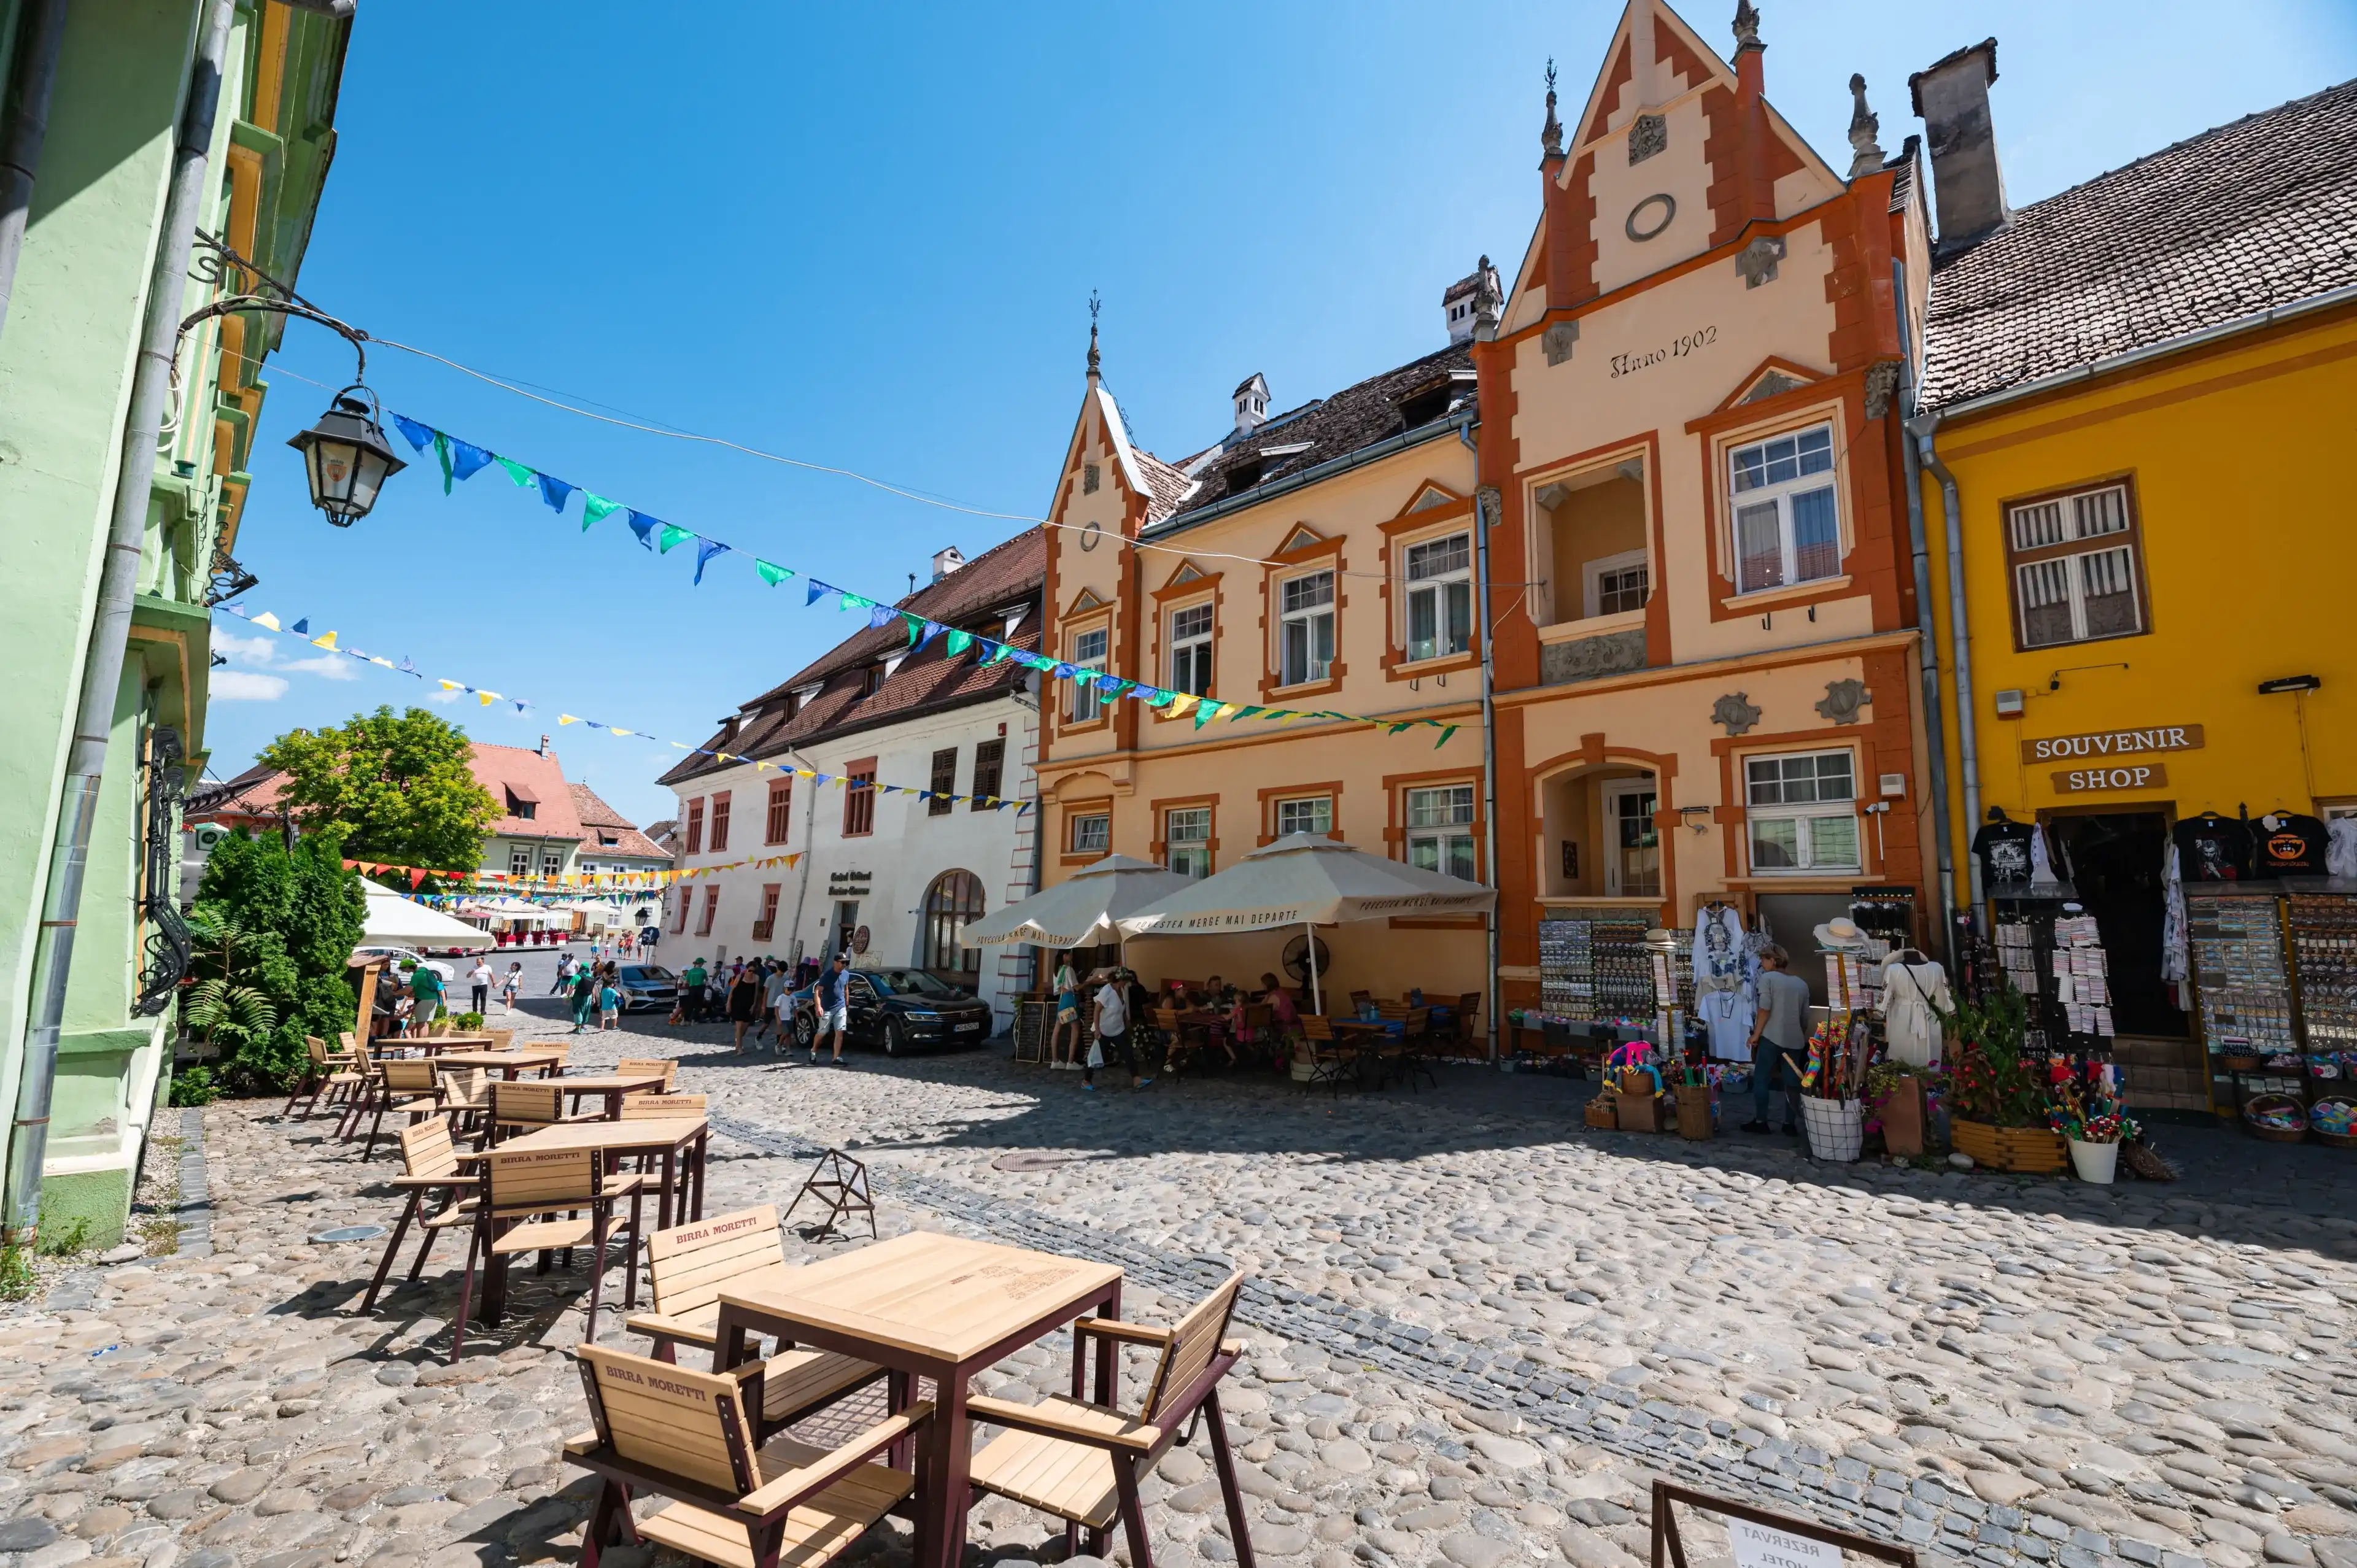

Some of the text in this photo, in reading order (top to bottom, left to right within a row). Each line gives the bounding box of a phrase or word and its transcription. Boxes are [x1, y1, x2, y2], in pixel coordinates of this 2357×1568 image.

[1610, 326, 1717, 379] Anno 1902
[2035, 728, 2189, 759] SOUVENIR
[2069, 767, 2150, 790] SHOP
[1136, 910, 1298, 929] POVESTEA MERGE MAI DEPARTE
[1031, 929, 1045, 941] MAI
[424, 1122, 440, 1132] MORETTI
[536, 1153, 580, 1162] MORETTI
[676, 1217, 757, 1245] BIRRA MORETTI
[605, 1365, 706, 1402] BIRRA MORETTI
